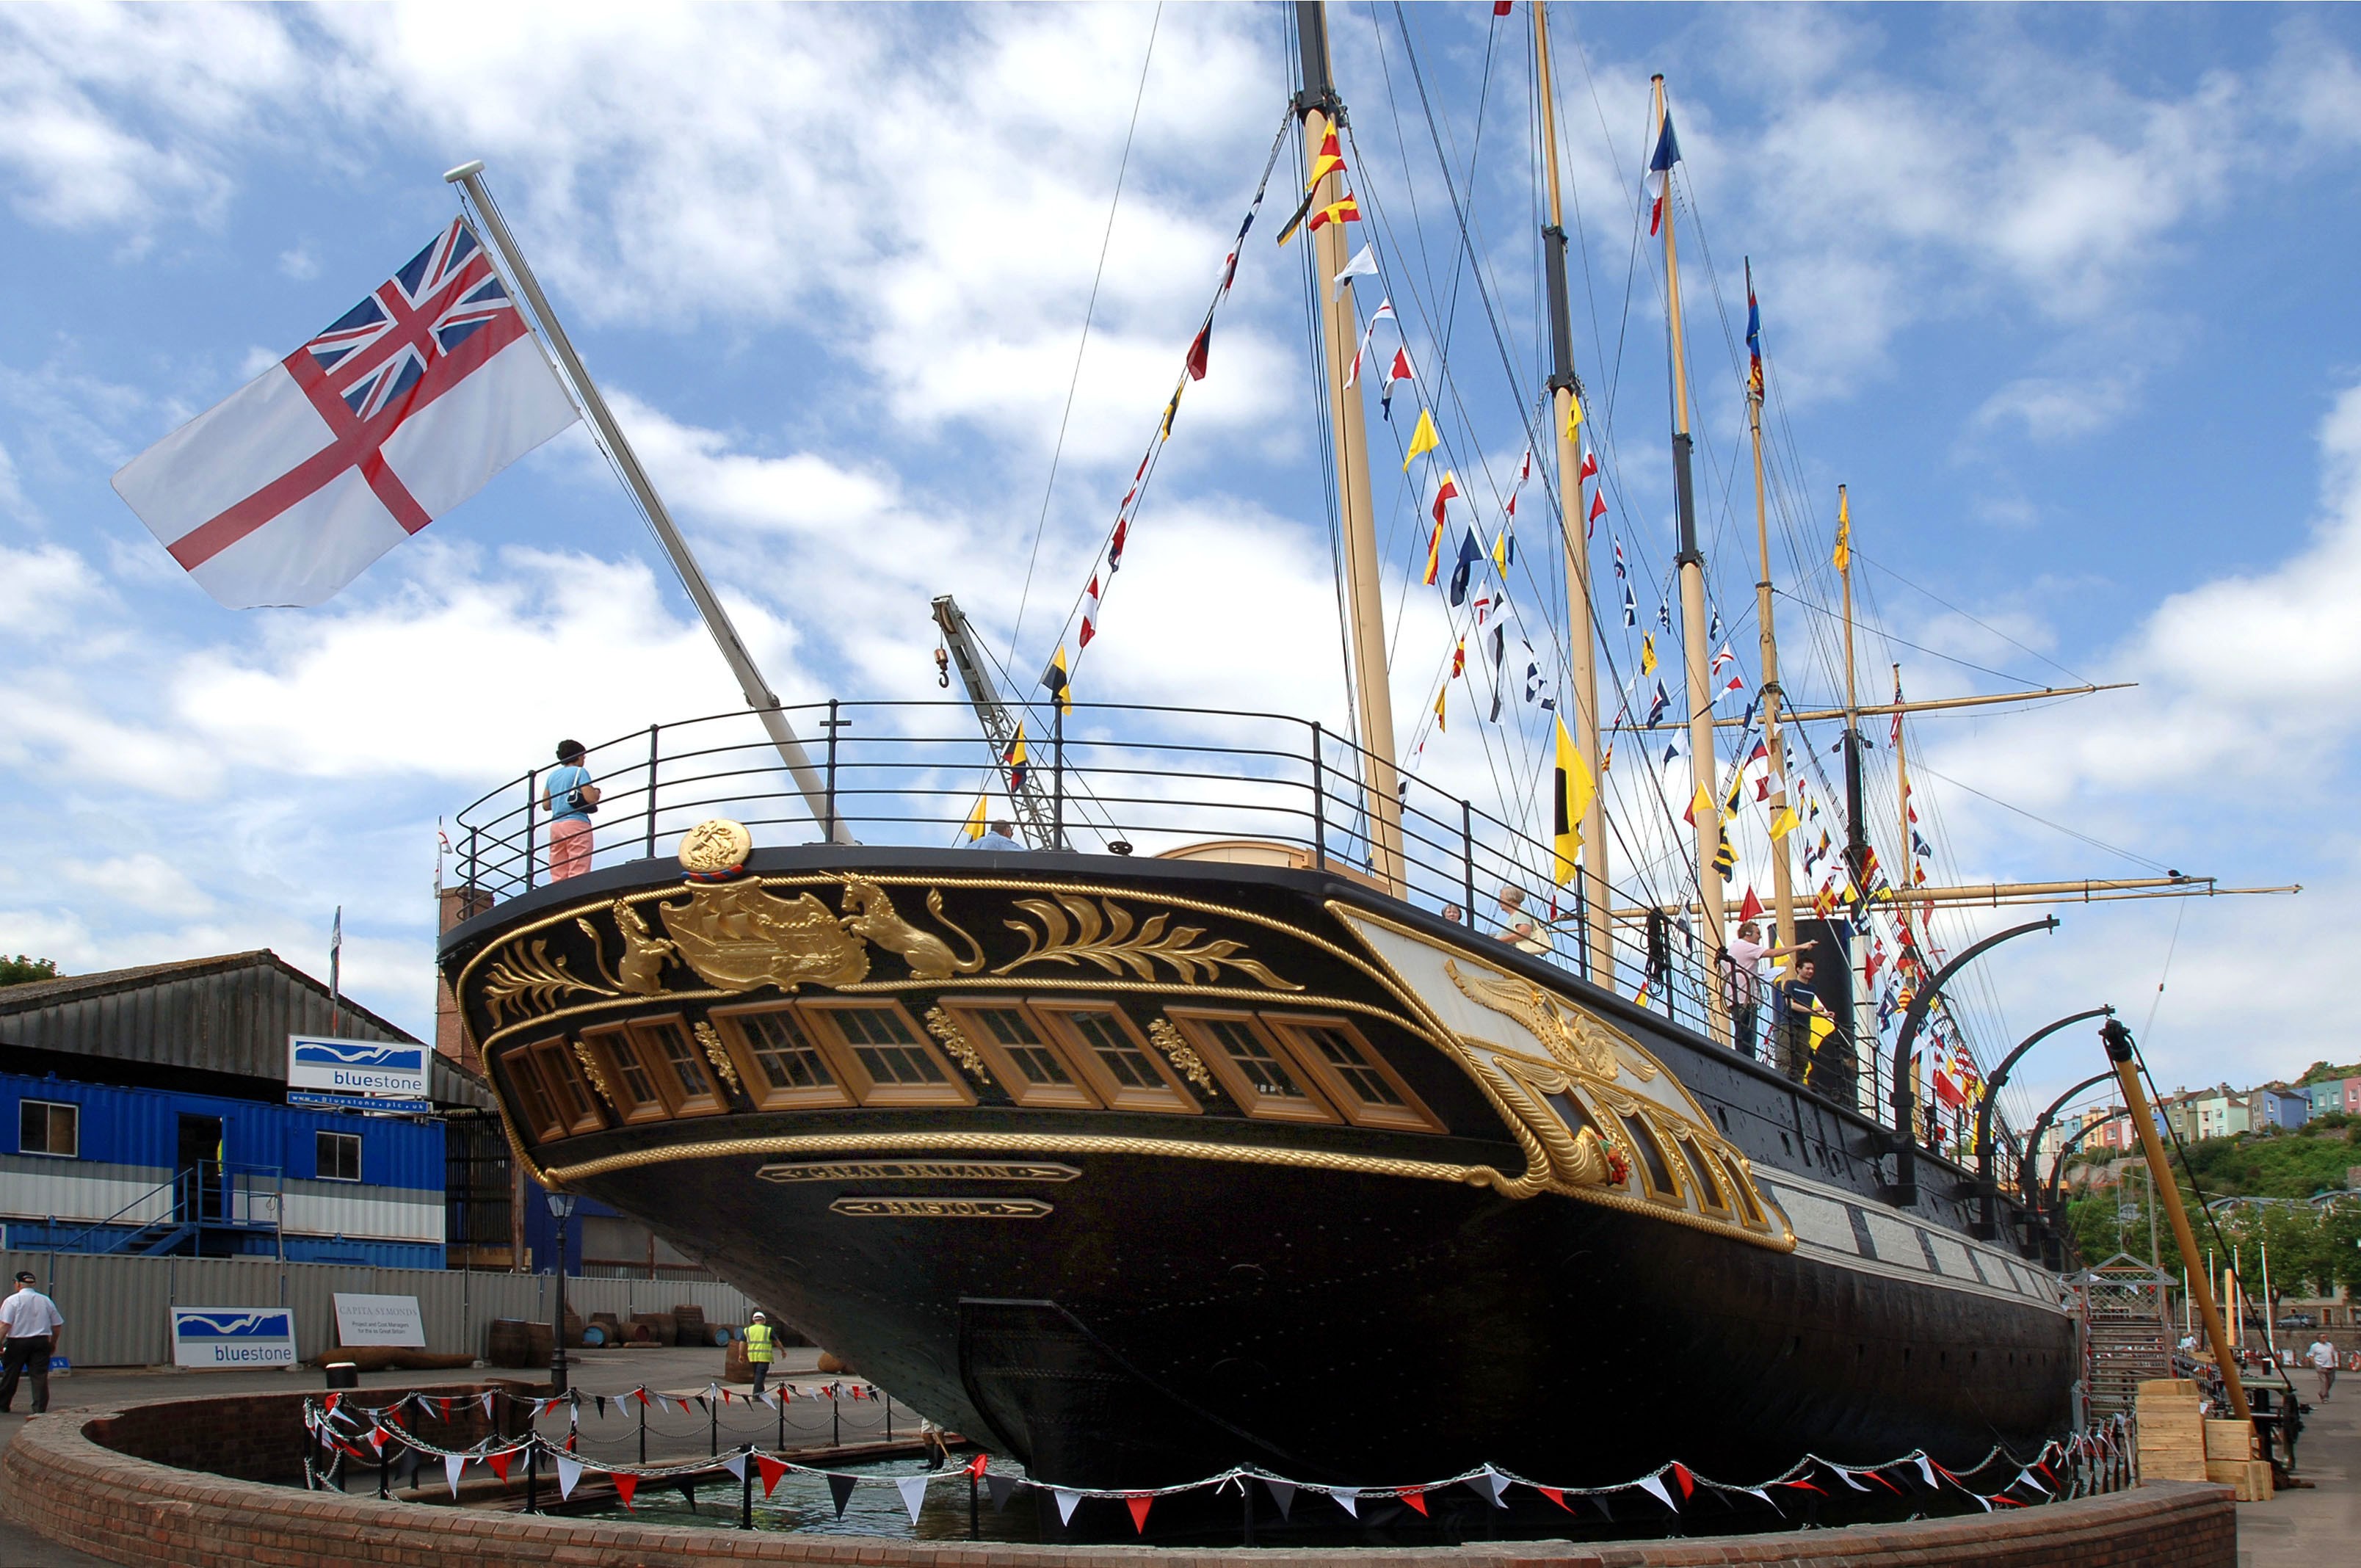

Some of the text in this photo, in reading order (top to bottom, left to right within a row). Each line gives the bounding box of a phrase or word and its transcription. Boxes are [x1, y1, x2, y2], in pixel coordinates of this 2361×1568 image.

[335, 1071, 422, 1090] bluestone
[809, 1164, 1012, 1178] GREAT BRITAIN
[882, 1202, 991, 1215] BRISTOL
[339, 1307, 418, 1316] CAPITA SYMONDS
[215, 1345, 291, 1361] bluestone
